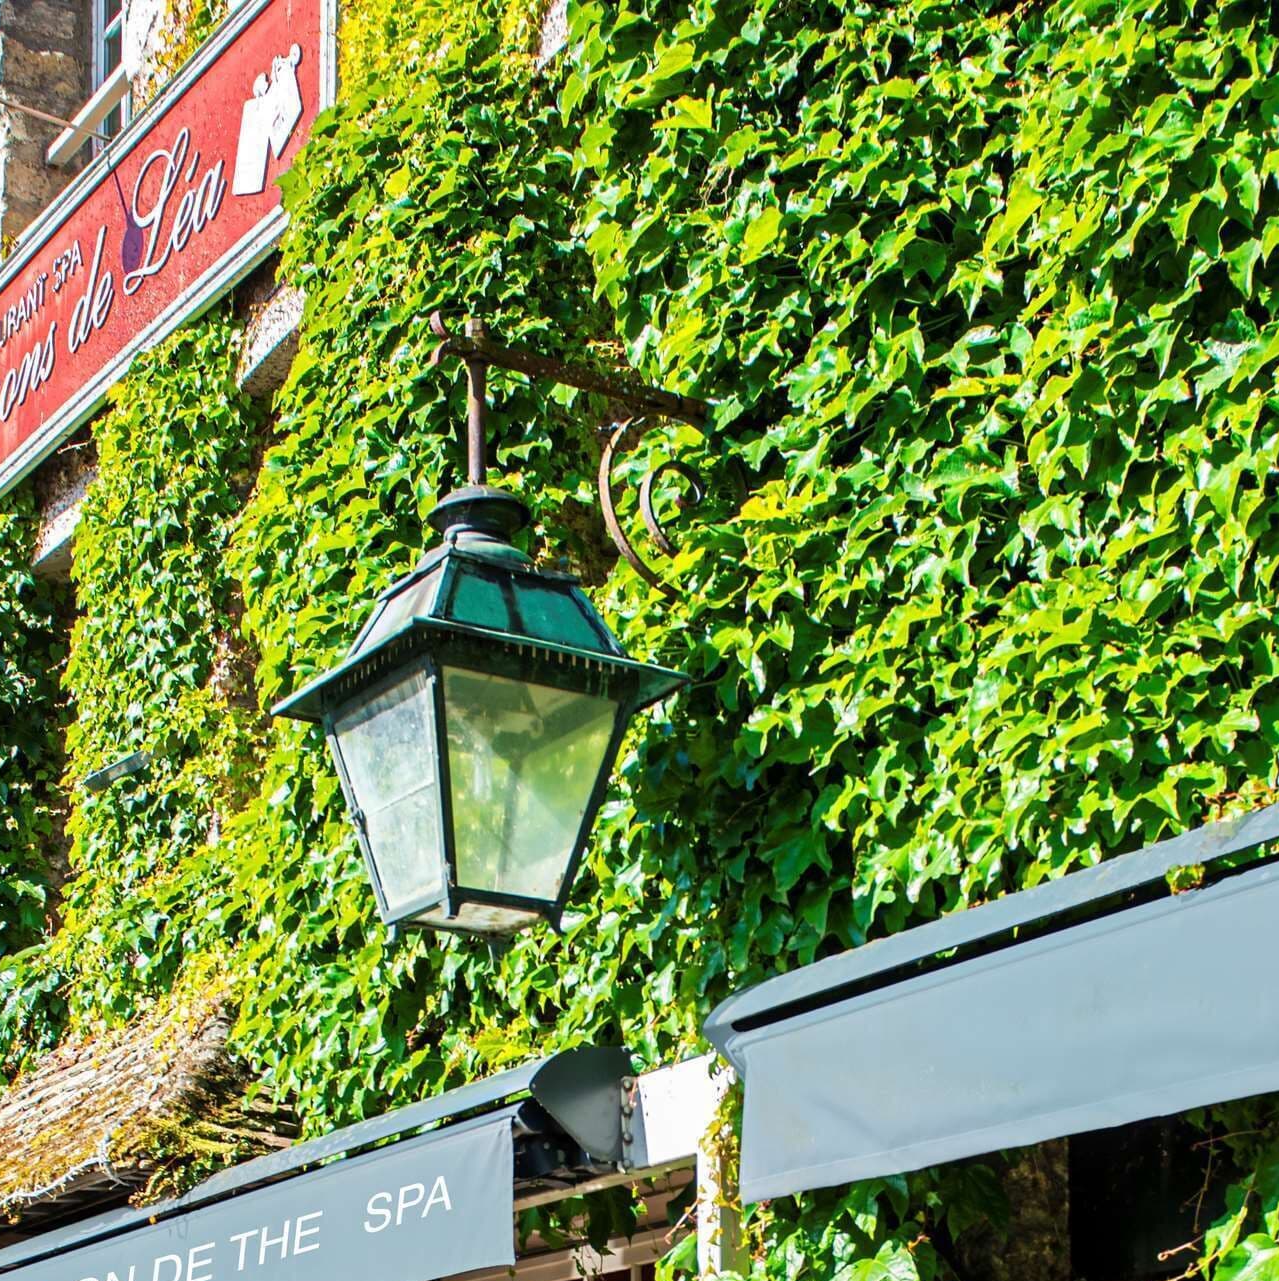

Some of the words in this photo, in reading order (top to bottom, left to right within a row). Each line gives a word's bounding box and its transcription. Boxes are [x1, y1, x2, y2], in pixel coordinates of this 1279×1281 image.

[52, 240, 82, 292] SPA
[68, 225, 114, 353] de
[123, 128, 227, 295] Léa
[229, 1209, 324, 1272] THE
[363, 1175, 453, 1234] SPA
